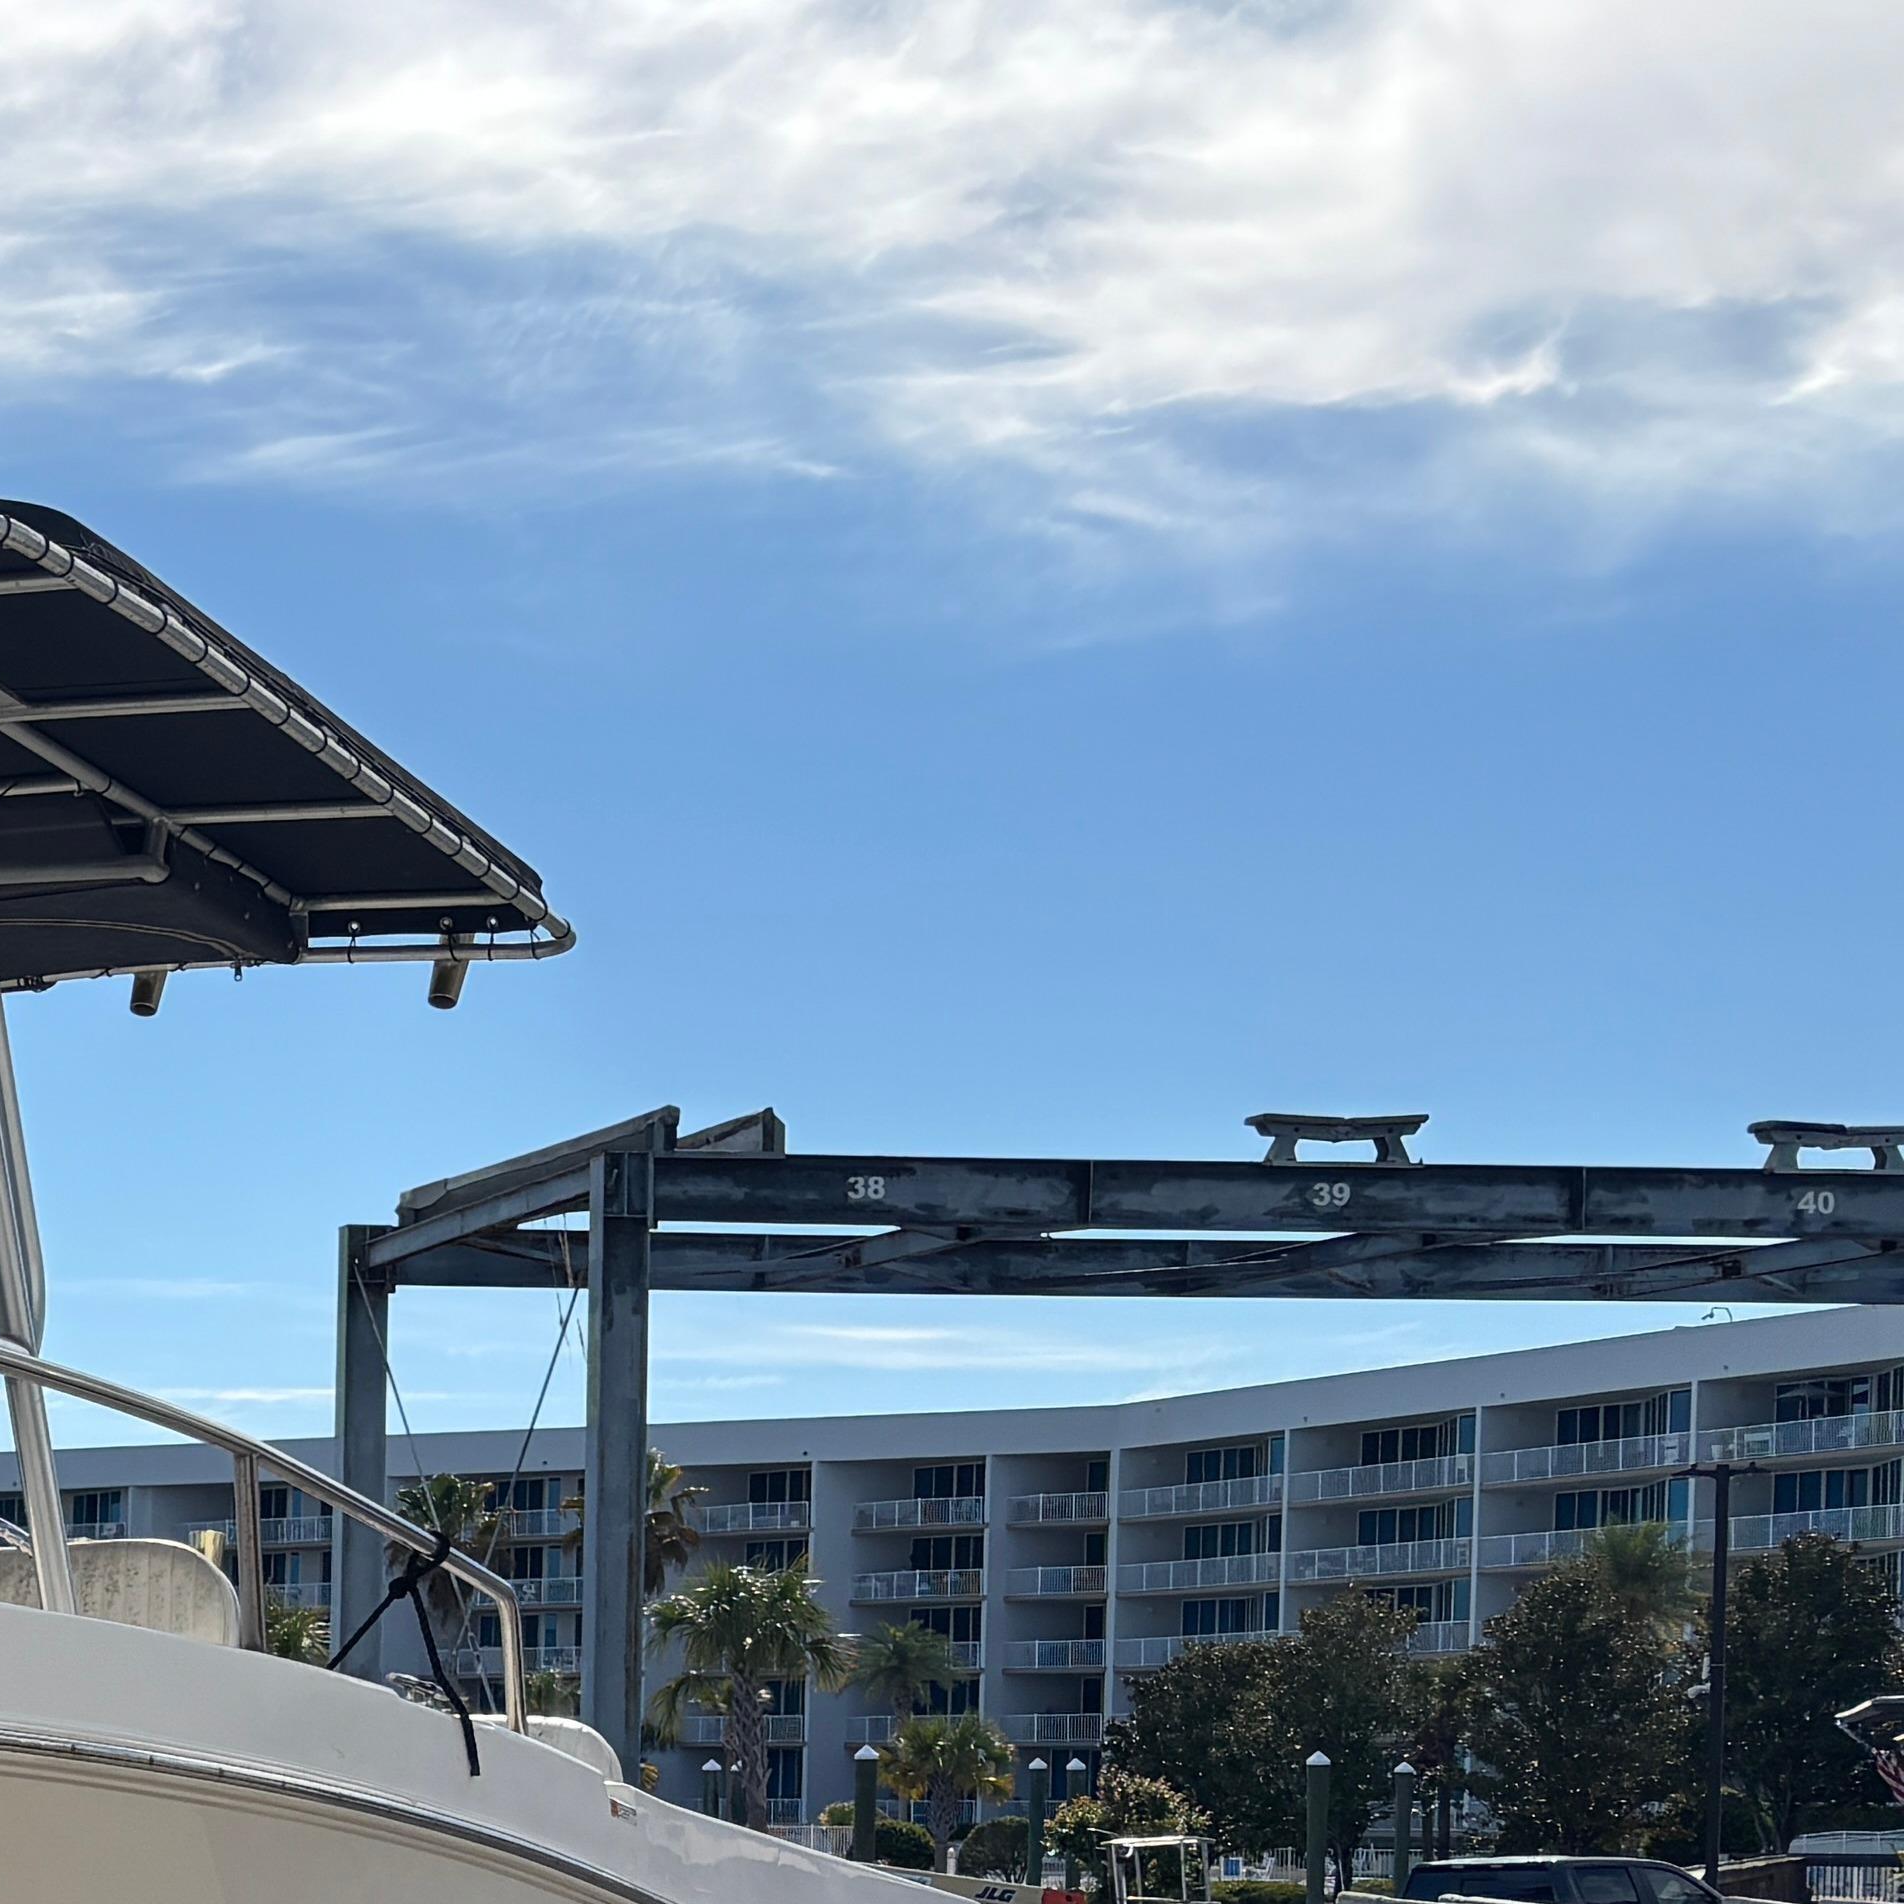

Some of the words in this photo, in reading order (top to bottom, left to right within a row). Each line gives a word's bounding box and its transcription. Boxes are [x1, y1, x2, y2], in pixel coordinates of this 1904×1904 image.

[847, 1176, 885, 1199] 38
[1313, 1182, 1350, 1206] 39
[1797, 1191, 1835, 1214] 40
[975, 1886, 1016, 1903] JLG
